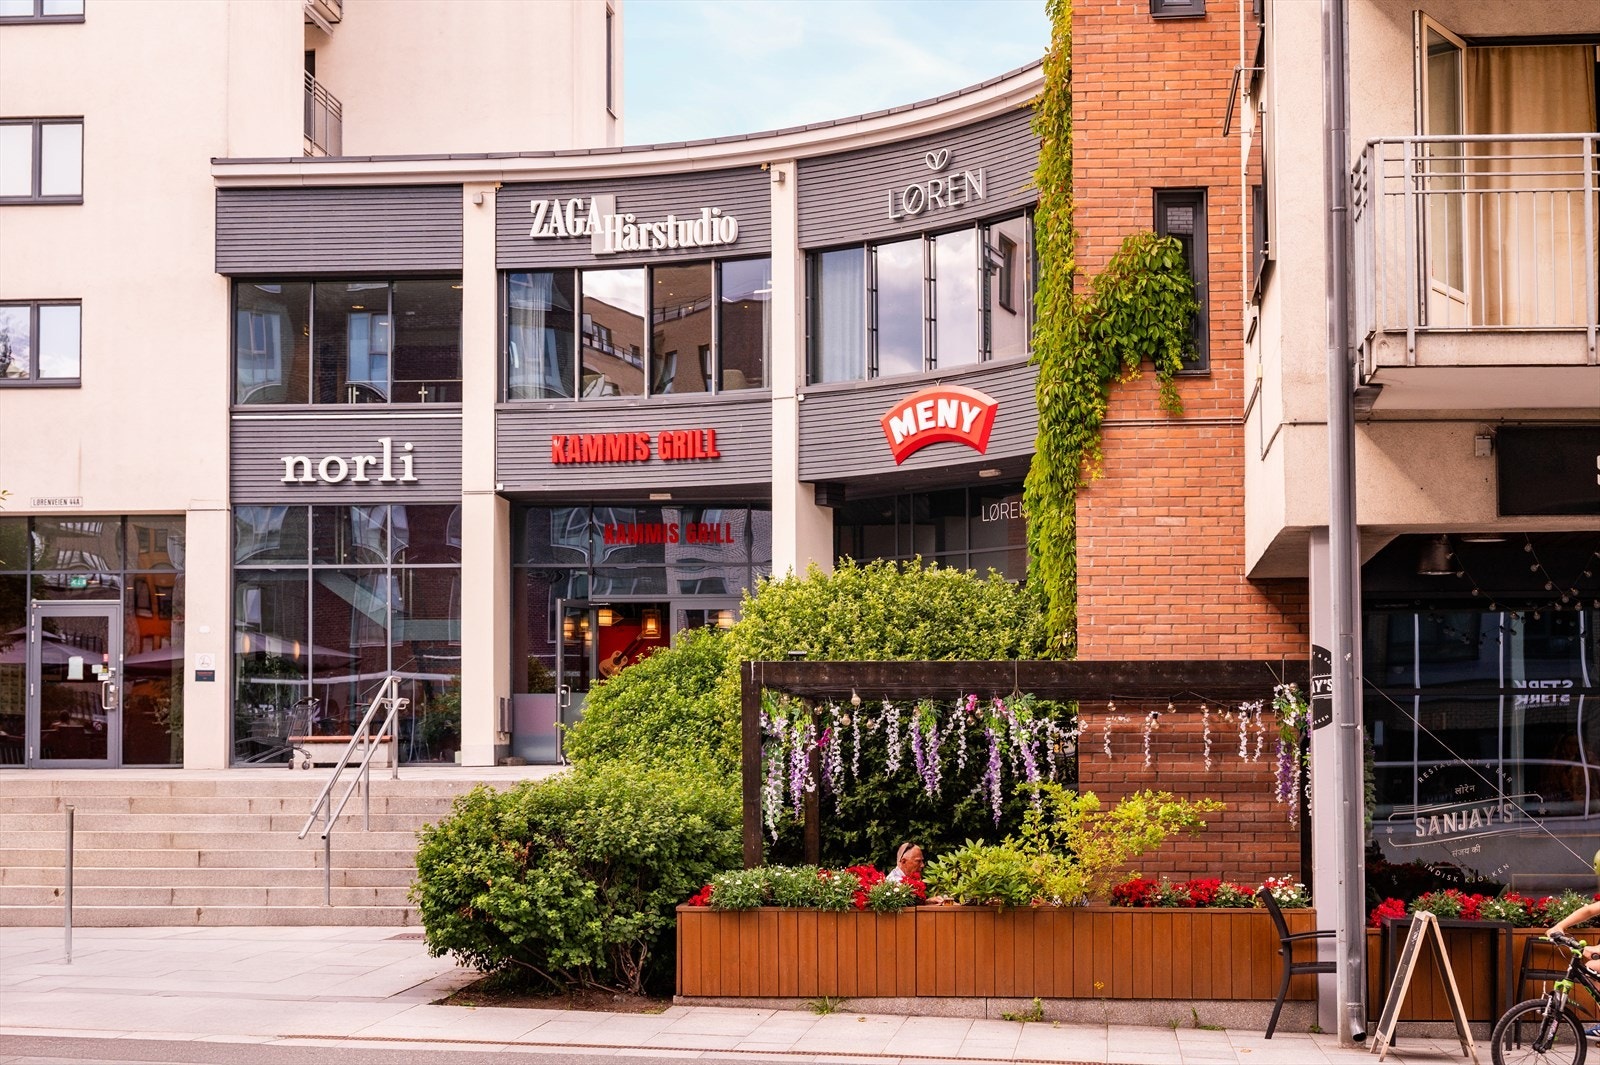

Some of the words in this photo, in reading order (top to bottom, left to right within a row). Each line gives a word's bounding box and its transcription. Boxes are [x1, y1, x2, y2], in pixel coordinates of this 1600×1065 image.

[888, 168, 987, 219] LØREN
[529, 197, 604, 238] ZAGA
[602, 207, 739, 252] Hårstudio
[888, 398, 982, 445] MENY
[280, 437, 418, 483] norli
[551, 433, 650, 464] KAMMIS
[658, 428, 720, 461] GRILL
[603, 523, 679, 545] KAMMIS
[685, 523, 734, 544] GRILL
[1415, 803, 1514, 837] SANJAY'S
[1424, 863, 1459, 883] INDISK
